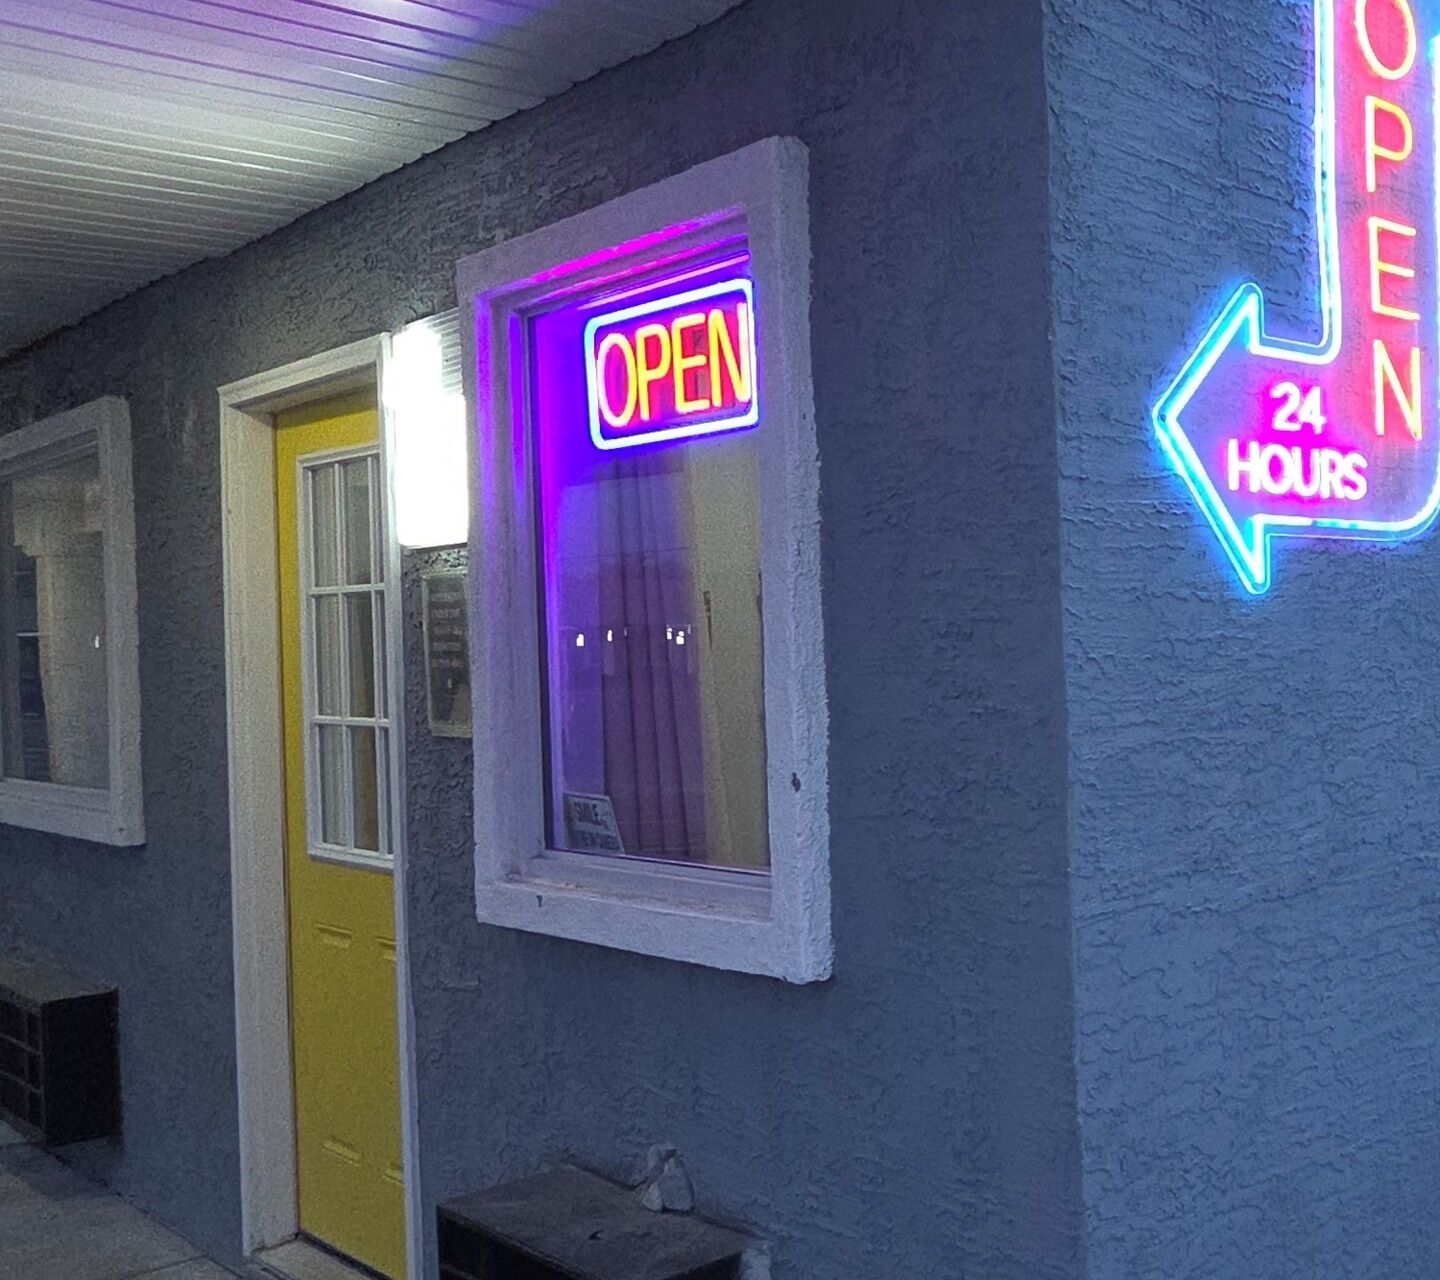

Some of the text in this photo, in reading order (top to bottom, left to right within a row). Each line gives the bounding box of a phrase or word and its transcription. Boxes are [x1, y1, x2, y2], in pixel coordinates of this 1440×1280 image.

[597, 301, 751, 427] OPEN
[1270, 382, 1325, 435] 24
[1227, 436, 1368, 501] HOURS
